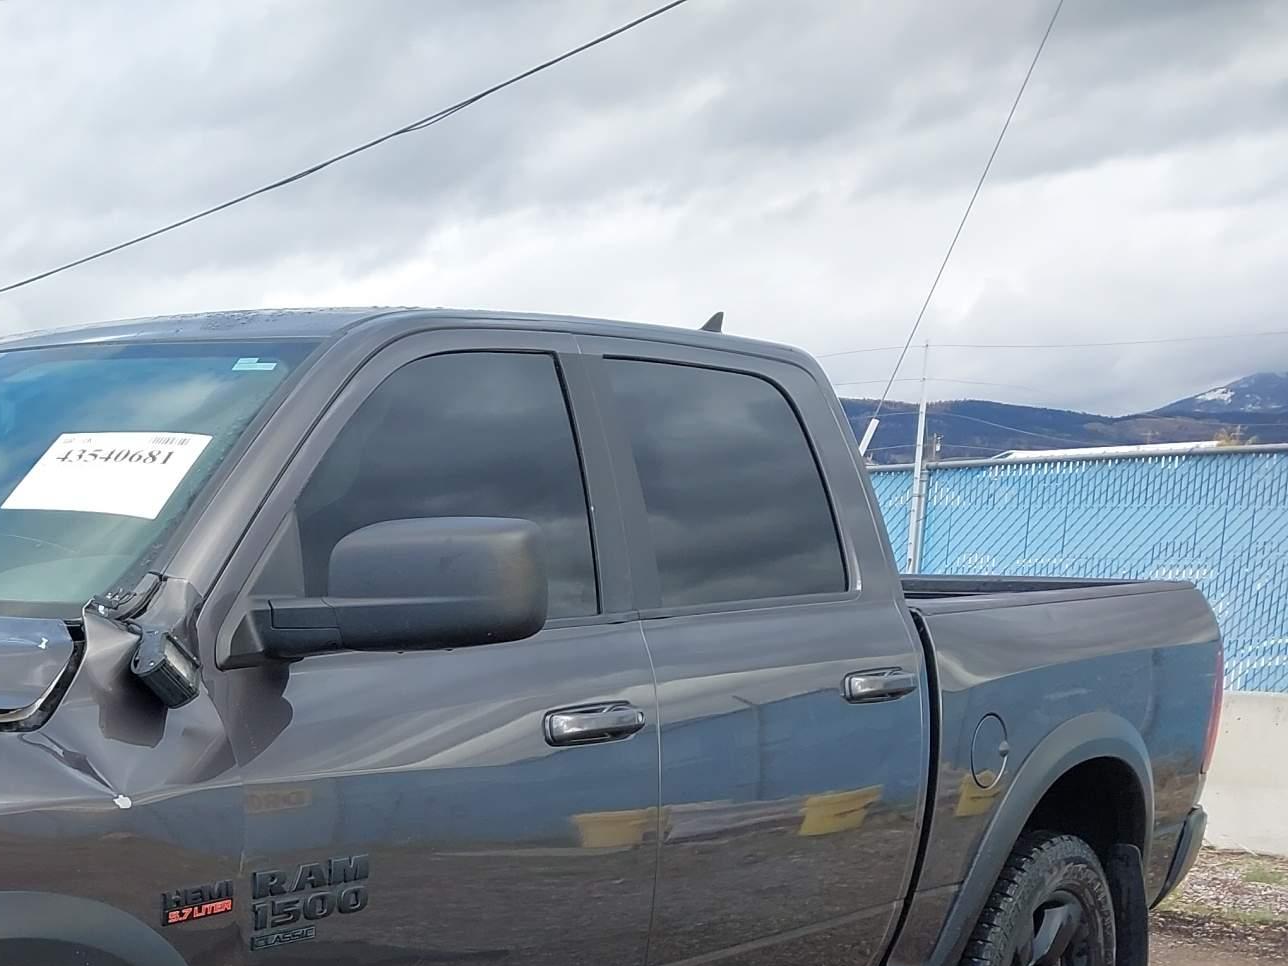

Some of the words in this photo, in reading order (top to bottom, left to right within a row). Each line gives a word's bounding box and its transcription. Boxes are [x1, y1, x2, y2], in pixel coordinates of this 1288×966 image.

[56, 448, 175, 465] 43540681
[251, 853, 369, 899] RAM
[161, 878, 234, 908] HEMI
[167, 907, 193, 924] 5.7
[193, 900, 233, 919] LITER
[252, 886, 369, 931] 1500
[254, 926, 315, 949] CLASSIC
